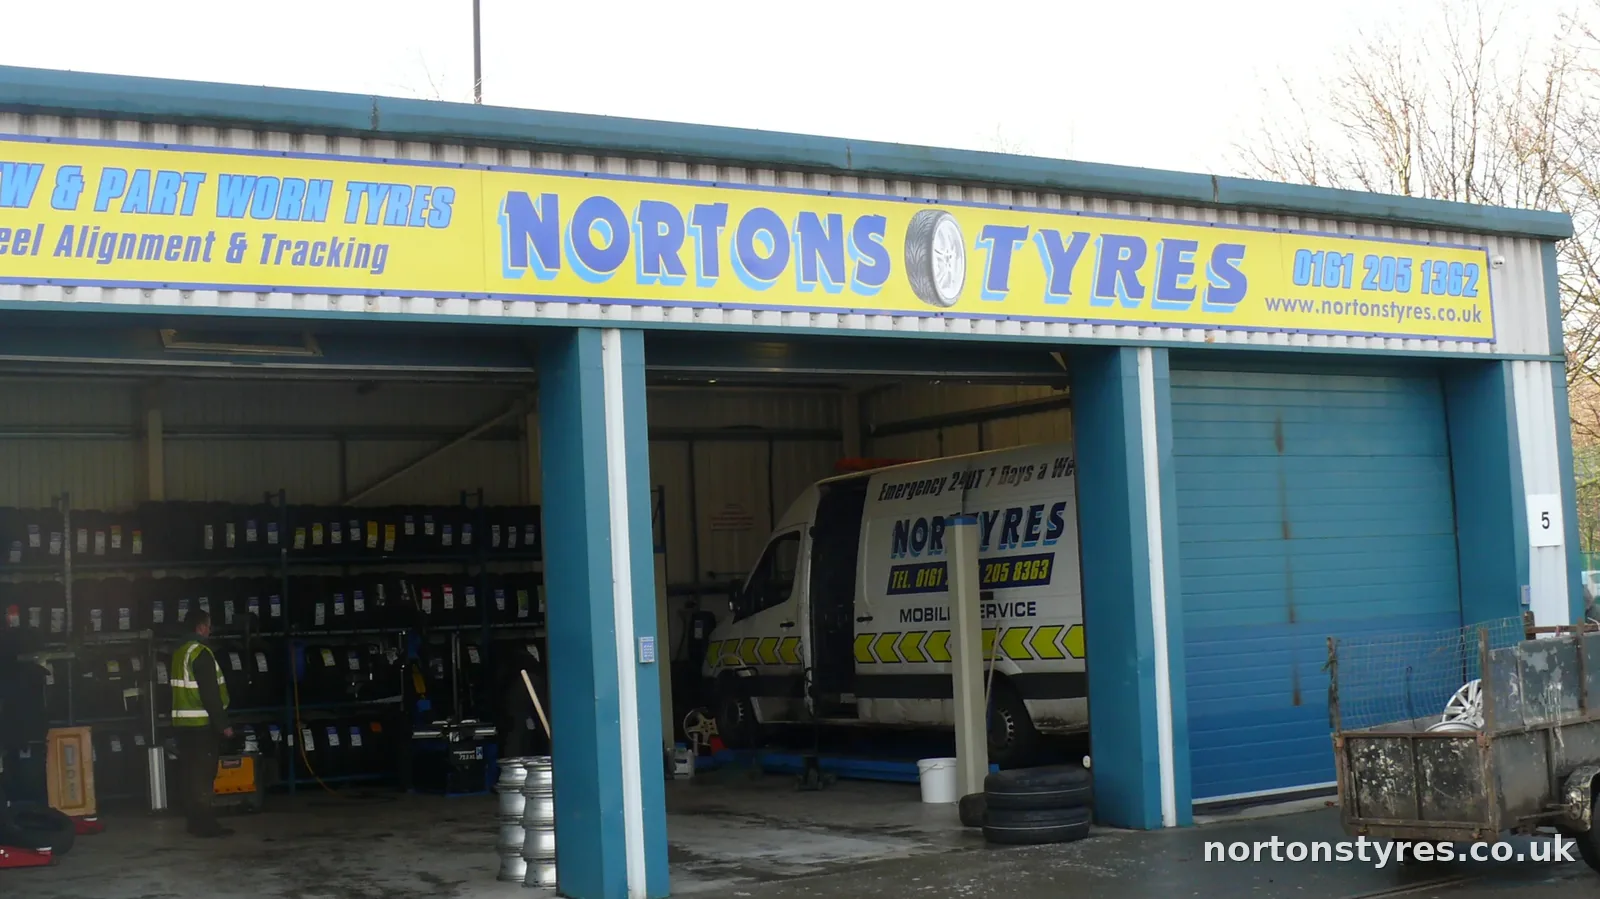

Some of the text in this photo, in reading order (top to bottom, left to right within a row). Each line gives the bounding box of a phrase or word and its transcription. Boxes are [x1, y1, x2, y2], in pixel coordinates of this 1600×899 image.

[0, 161, 456, 229] W & PART WORN TYRES
[53, 224, 217, 264] Alignment
[226, 232, 247, 263] &
[260, 234, 389, 275] Tracking
[498, 191, 891, 297] NORTONS
[975, 225, 1248, 313] TYRES
[1293, 249, 1479, 298] 0161 205 1362
[1265, 296, 1482, 327] www.nortonstyres.co.uk
[878, 477, 947, 502] Emergency
[999, 464, 1035, 488] Days
[1037, 462, 1049, 481] a
[1051, 457, 1077, 480] We
[892, 502, 1067, 559] NOR YRES
[1540, 511, 1551, 530] 5
[892, 558, 1051, 590] TEL. 0161 205 8363
